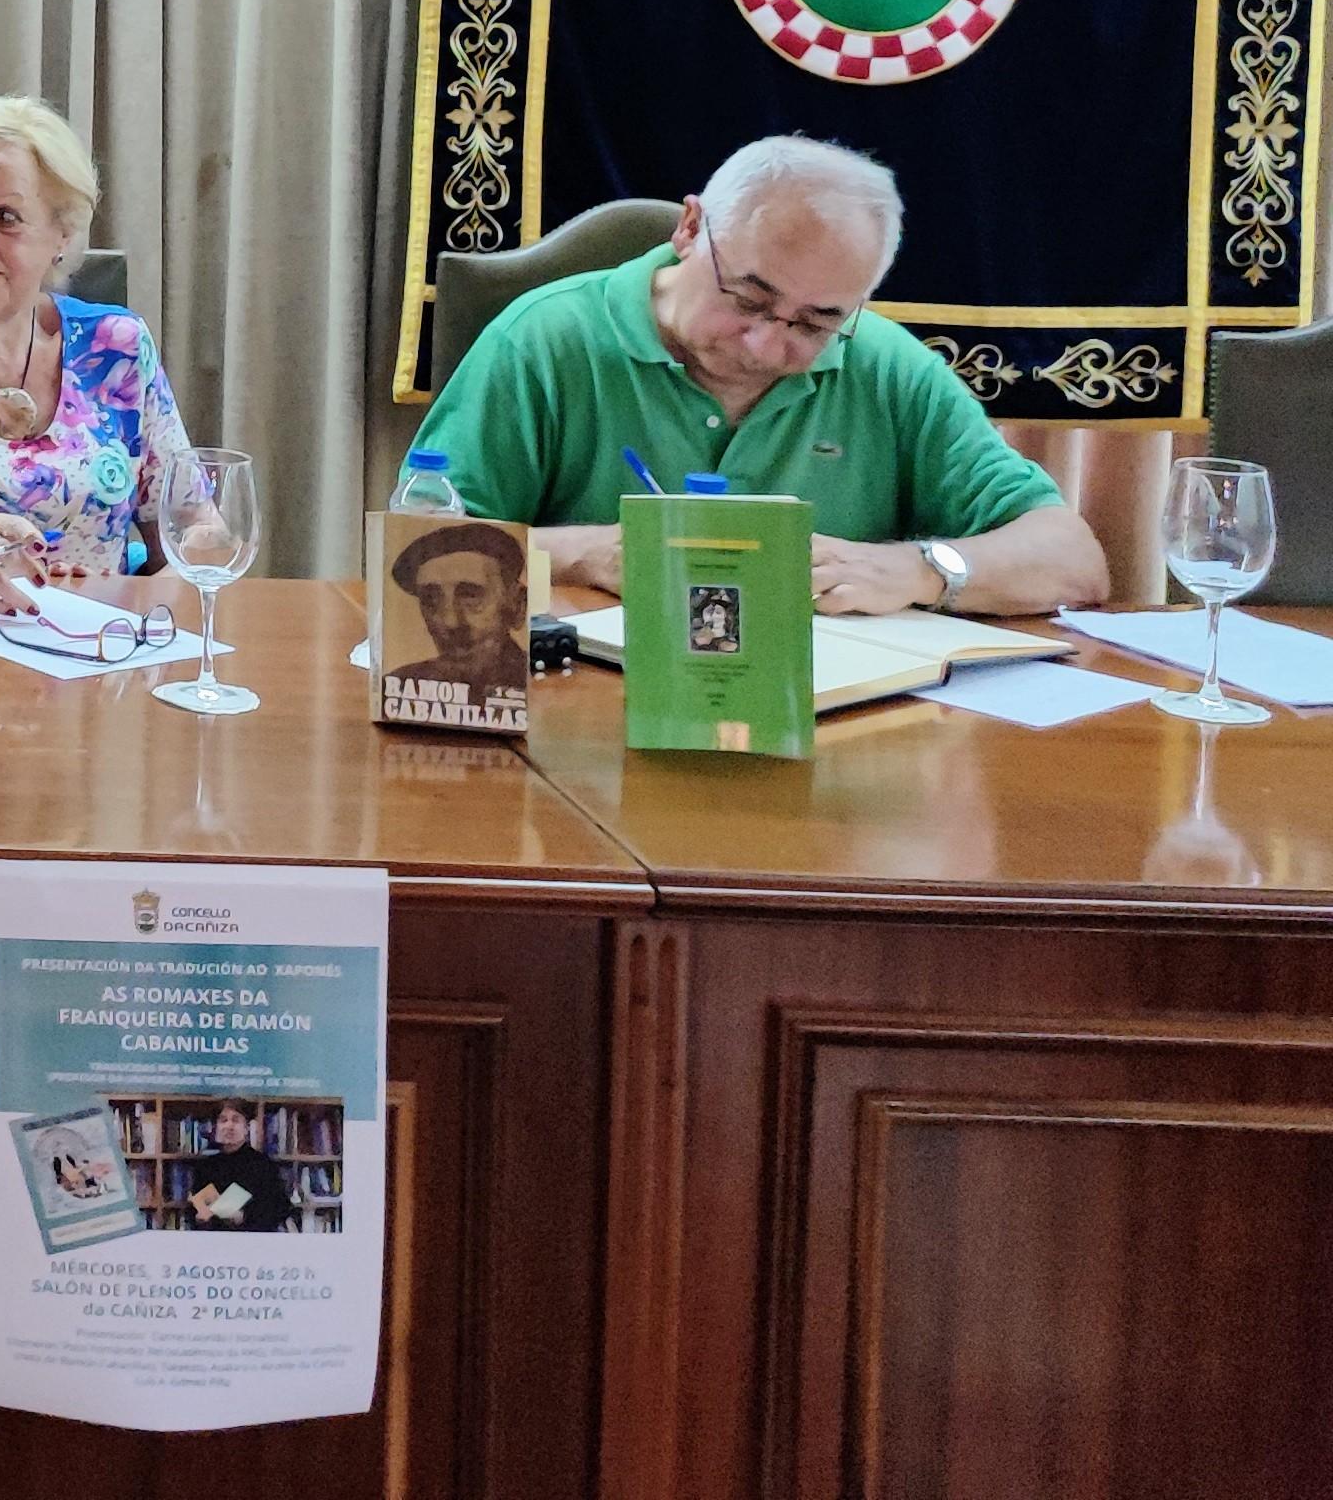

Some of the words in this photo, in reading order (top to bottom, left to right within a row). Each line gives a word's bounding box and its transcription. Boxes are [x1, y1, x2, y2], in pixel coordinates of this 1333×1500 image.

[384, 675, 470, 704] RAMON
[384, 698, 528, 731] CABANILLAS
[246, 964, 267, 976] AO
[101, 987, 127, 1002] AS
[133, 988, 233, 1005] ROMAXES
[239, 990, 269, 1006] DA
[59, 1008, 192, 1029] FRANQUEIRA
[199, 1012, 225, 1029] DE
[231, 1012, 312, 1031] RAMÓN
[121, 1035, 249, 1053] CABANILLAS
[162, 1265, 171, 1279] 3
[177, 1266, 249, 1280] AGOSTO
[281, 1267, 300, 1281] 20
[32, 1278, 92, 1296] SALÓN
[100, 1283, 119, 1297] DE
[128, 1284, 196, 1299] PLENOS
[207, 1286, 232, 1300] DO
[239, 1286, 332, 1300] CONCELLO
[214, 1307, 283, 1320] PLANTA
